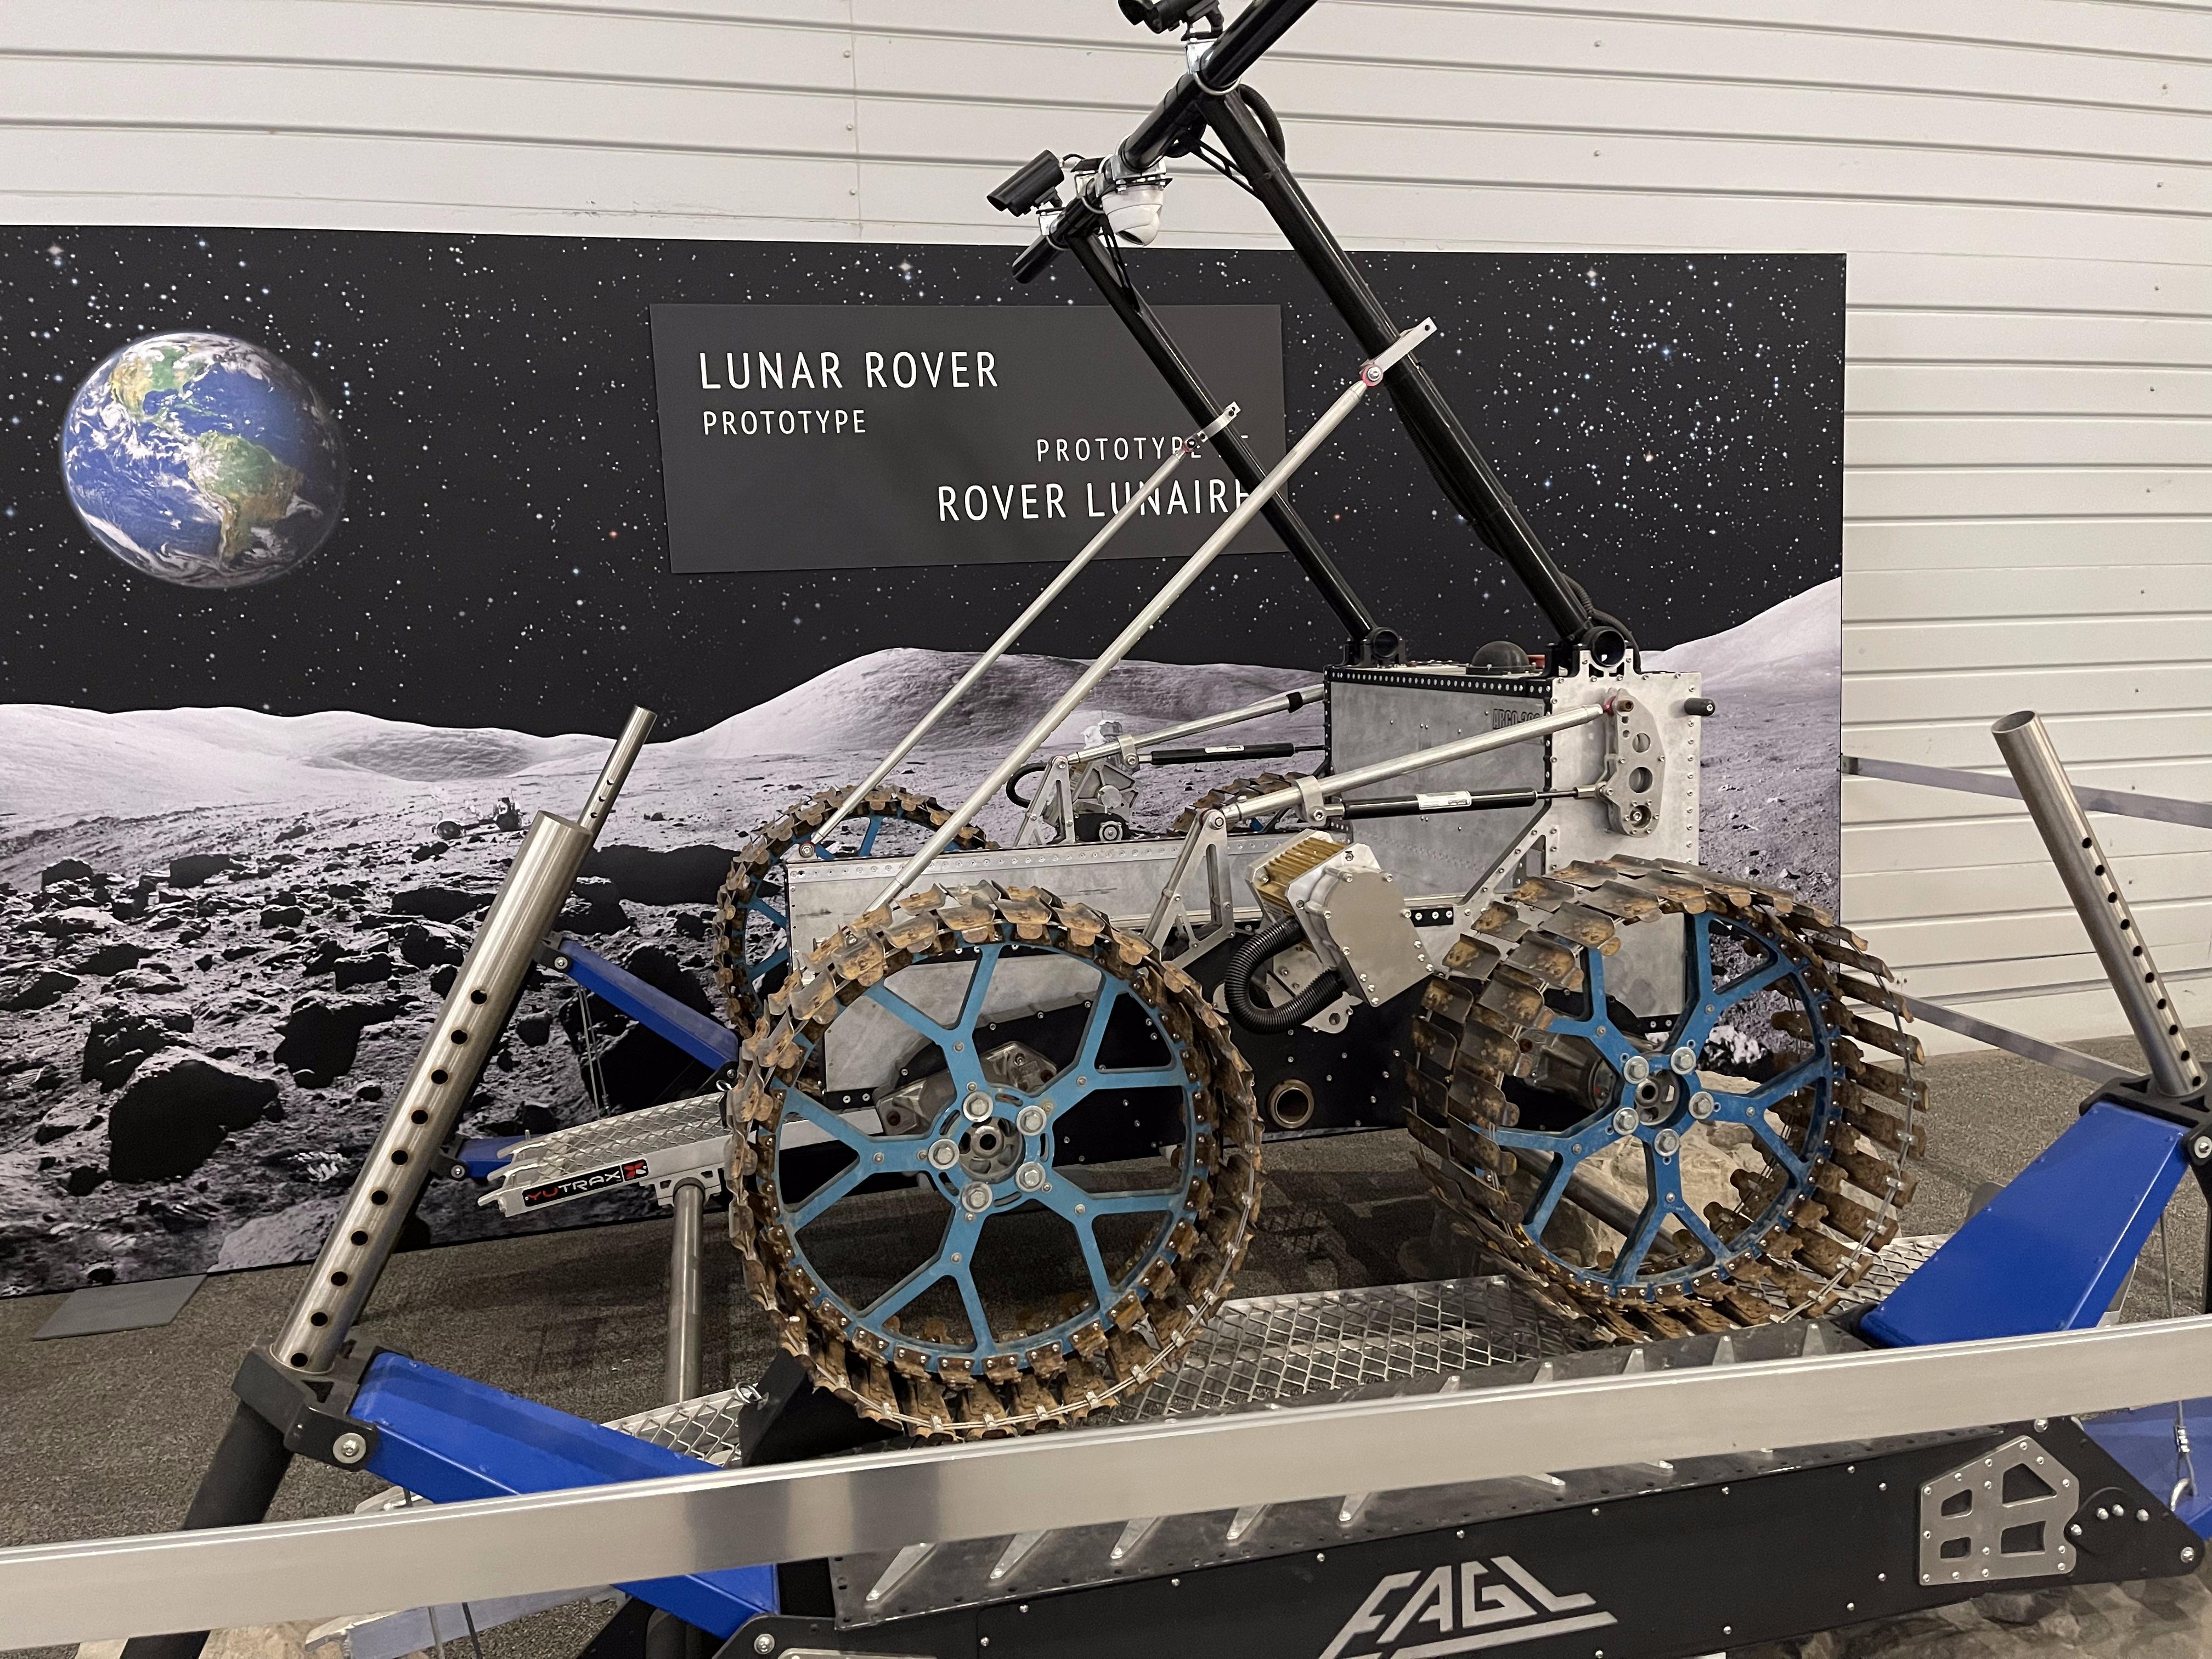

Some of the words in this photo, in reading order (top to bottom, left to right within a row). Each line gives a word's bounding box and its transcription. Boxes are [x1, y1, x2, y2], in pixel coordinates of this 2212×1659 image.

[699, 352, 843, 390] LUNAR
[865, 351, 998, 388] ROVER
[703, 410, 866, 435] PROTOTYPE
[938, 483, 1066, 521] ROVER
[1492, 708, 1541, 730] ARGO-
[528, 1170, 621, 1200] YUTRAX
